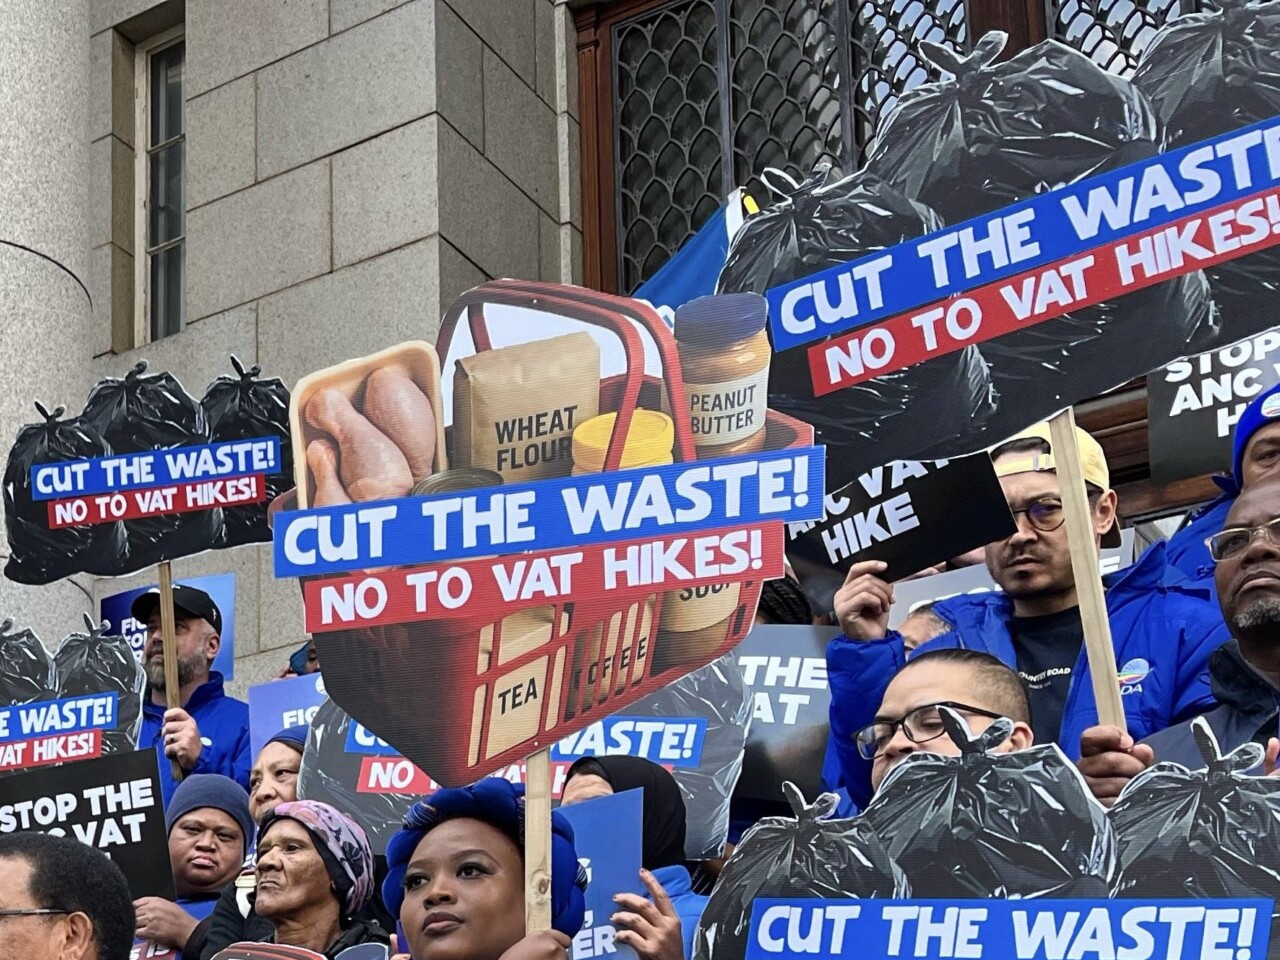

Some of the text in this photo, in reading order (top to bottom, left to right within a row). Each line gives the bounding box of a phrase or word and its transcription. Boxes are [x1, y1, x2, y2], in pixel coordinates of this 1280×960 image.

[781, 255, 893, 335] CUT
[917, 207, 1040, 288] THE
[824, 194, 1280, 385] NO TO VAT HIKES!
[690, 385, 757, 412] PEANUT
[1169, 368, 1263, 416] ANC
[495, 405, 578, 444] WHEAT
[690, 408, 754, 435] BUTTER
[36, 441, 275, 494] CUT THE WASTE!
[858, 459, 950, 499] VA
[55, 477, 258, 525] NO TO VAT HIKES!
[283, 506, 398, 566] CUT
[422, 492, 535, 551] THE
[562, 455, 810, 536] WASTE!
[821, 492, 920, 565] HIKE
[320, 531, 763, 625] NO TO VAT HIKES!
[738, 656, 828, 689] THE
[20, 696, 113, 734] WASTE!
[498, 677, 537, 716] TEA
[752, 692, 810, 725] AT
[34, 733, 94, 761] HIKES!
[367, 761, 415, 789] NO
[83, 779, 155, 816] THE
[71, 813, 146, 848] VAT
[757, 905, 861, 955] CUT
[882, 906, 987, 959] THE
